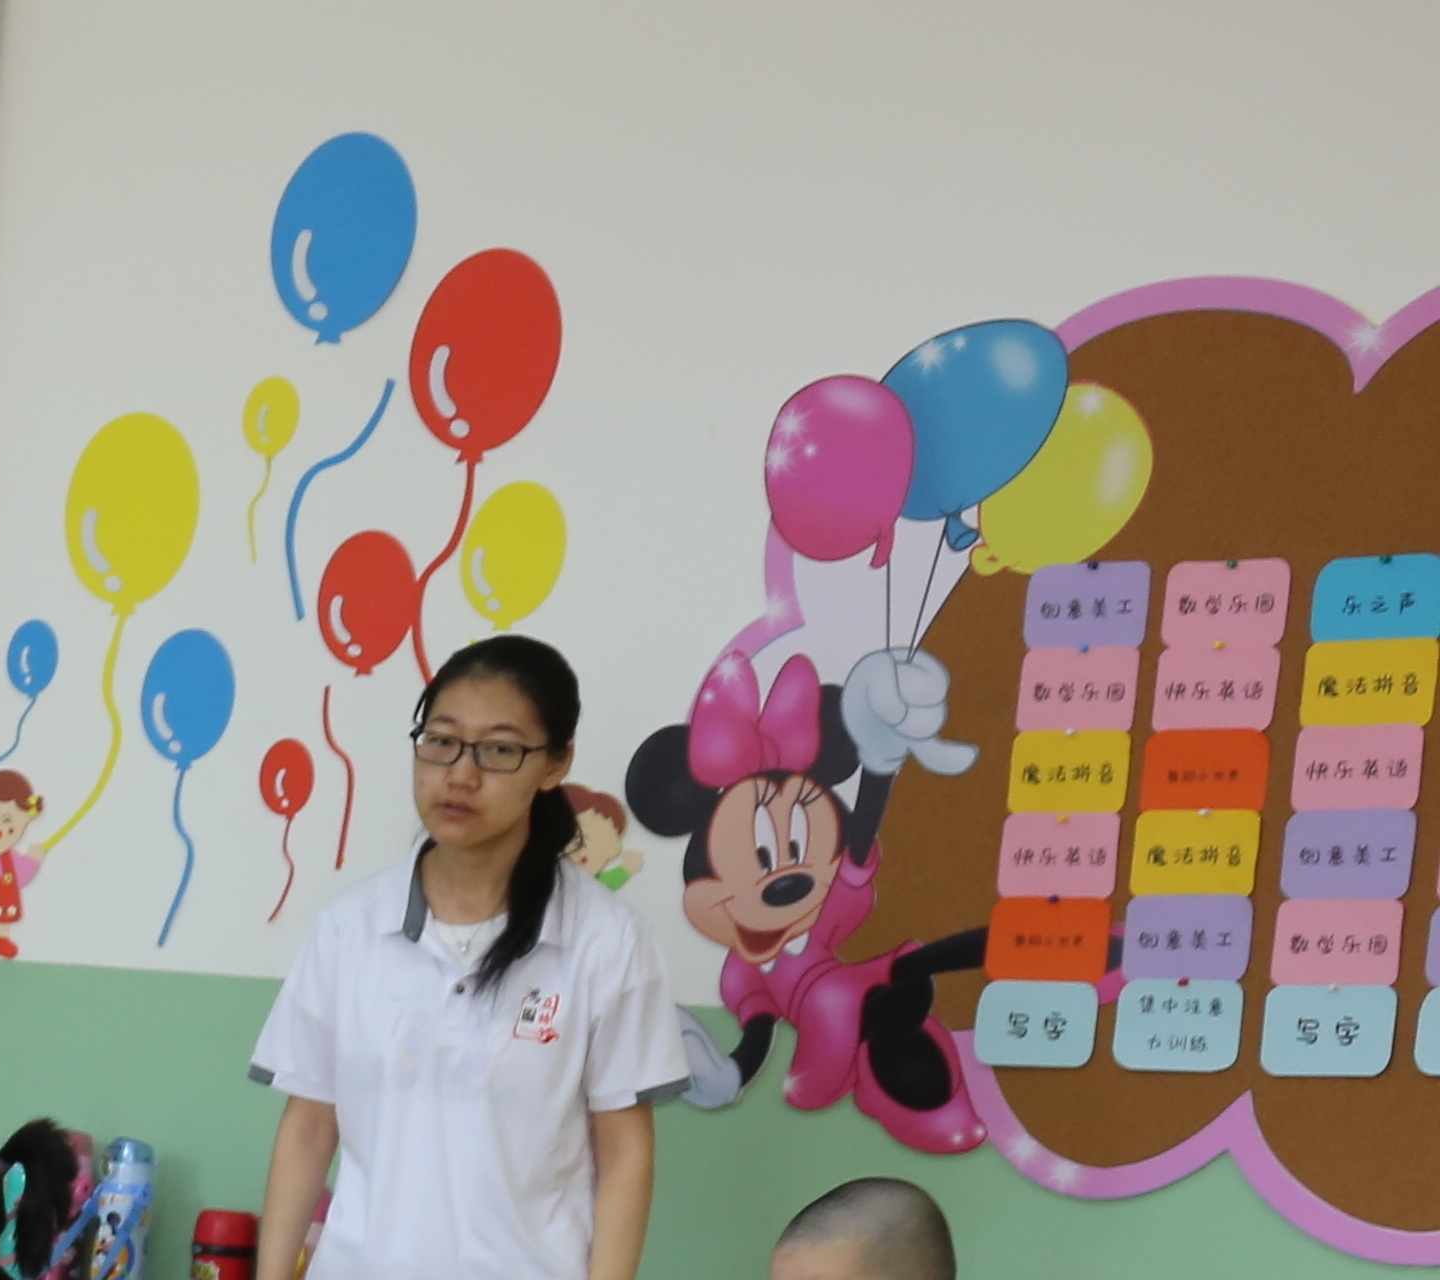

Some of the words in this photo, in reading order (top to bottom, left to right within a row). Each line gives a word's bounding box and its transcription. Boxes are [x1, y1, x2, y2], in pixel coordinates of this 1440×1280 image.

[1040, 597, 1133, 620] 创意美工
[1178, 593, 1275, 616] 数学乐园
[1033, 681, 1126, 702] 数学乐园
[1164, 680, 1264, 702] 快乐英语
[1318, 673, 1418, 697] 魔法拼音
[1022, 762, 1114, 785] 魔法拼音
[1305, 758, 1411, 781] 快乐英语
[1013, 847, 1108, 868] 快乐英语
[1147, 845, 1241, 867] 魔法拼音
[1299, 844, 1398, 867] 创意美工
[1138, 928, 1233, 951] 创意美工
[1289, 932, 1388, 956] 数学乐园
[1139, 995, 1223, 1016] 集中注意
[1007, 1011, 1068, 1040] 写字
[1296, 1015, 1361, 1045] 写字
